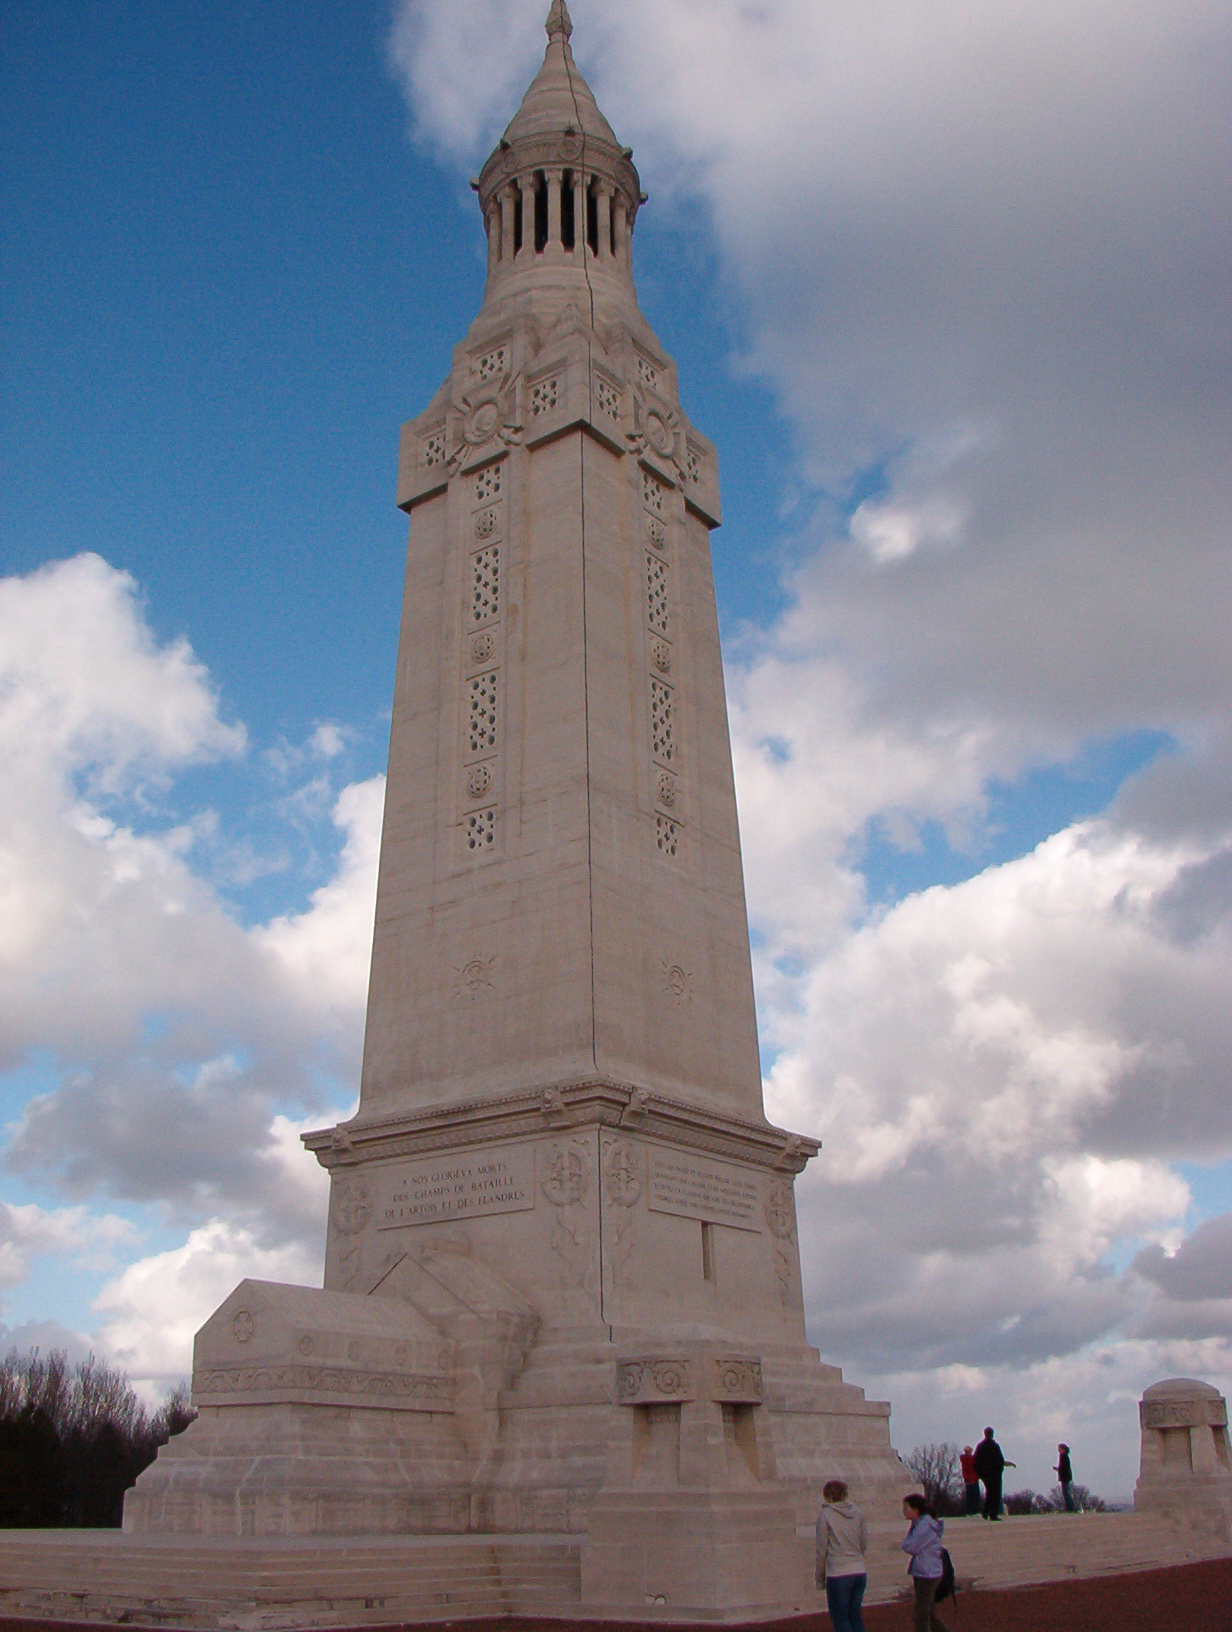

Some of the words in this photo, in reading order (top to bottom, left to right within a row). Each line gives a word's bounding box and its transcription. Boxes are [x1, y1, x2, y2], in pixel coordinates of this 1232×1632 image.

[477, 1162, 507, 1175] MORTS
[393, 1192, 409, 1202] DES
[414, 1186, 450, 1200] CHAMPS
[454, 1183, 464, 1193] DE
[471, 1176, 514, 1191] BATAILLE
[385, 1209, 394, 1218] DE
[457, 1198, 474, 1209] DES
[478, 1190, 525, 1206] FLANDRES
